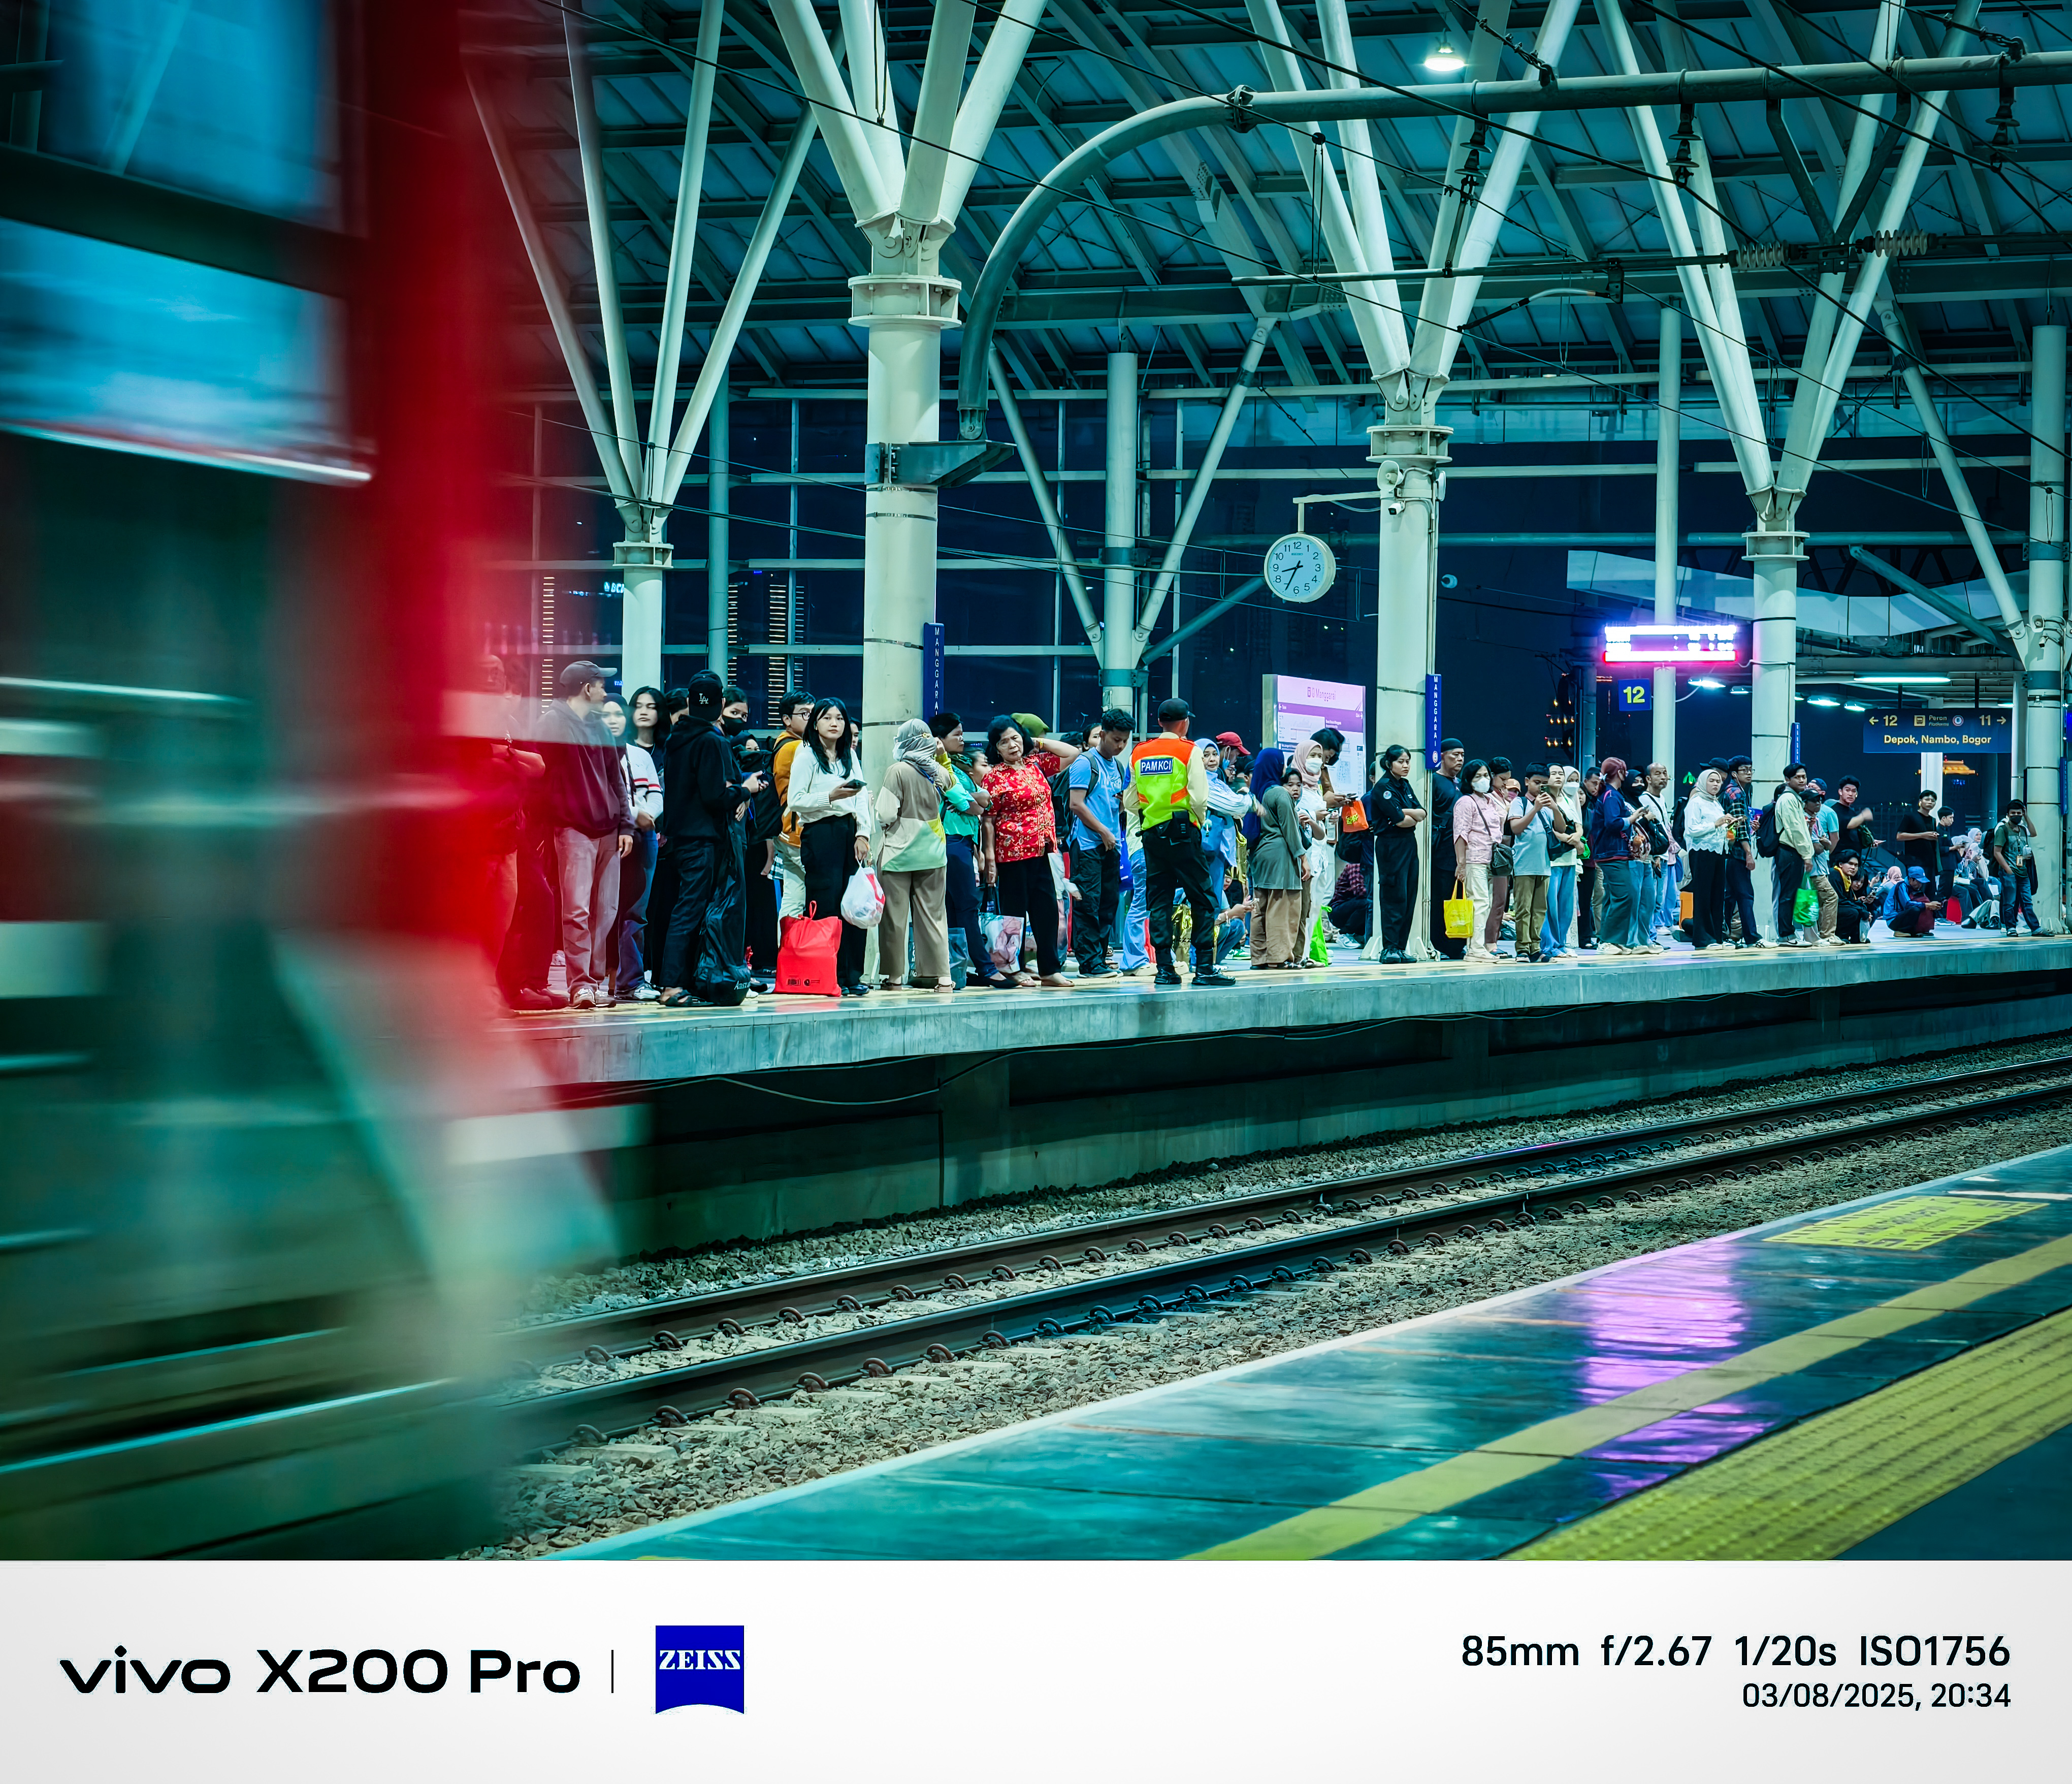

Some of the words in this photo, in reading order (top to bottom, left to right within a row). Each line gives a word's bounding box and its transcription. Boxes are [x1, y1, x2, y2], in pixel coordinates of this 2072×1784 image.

[1316, 688, 1336, 702] Manggarai
[1623, 686, 1645, 703] 12
[1883, 715, 1898, 726] 12
[1979, 715, 1991, 726] 11
[1884, 735, 1918, 745] Depok,
[1921, 735, 1959, 745] Nambo,
[1962, 735, 1992, 745] Bogor
